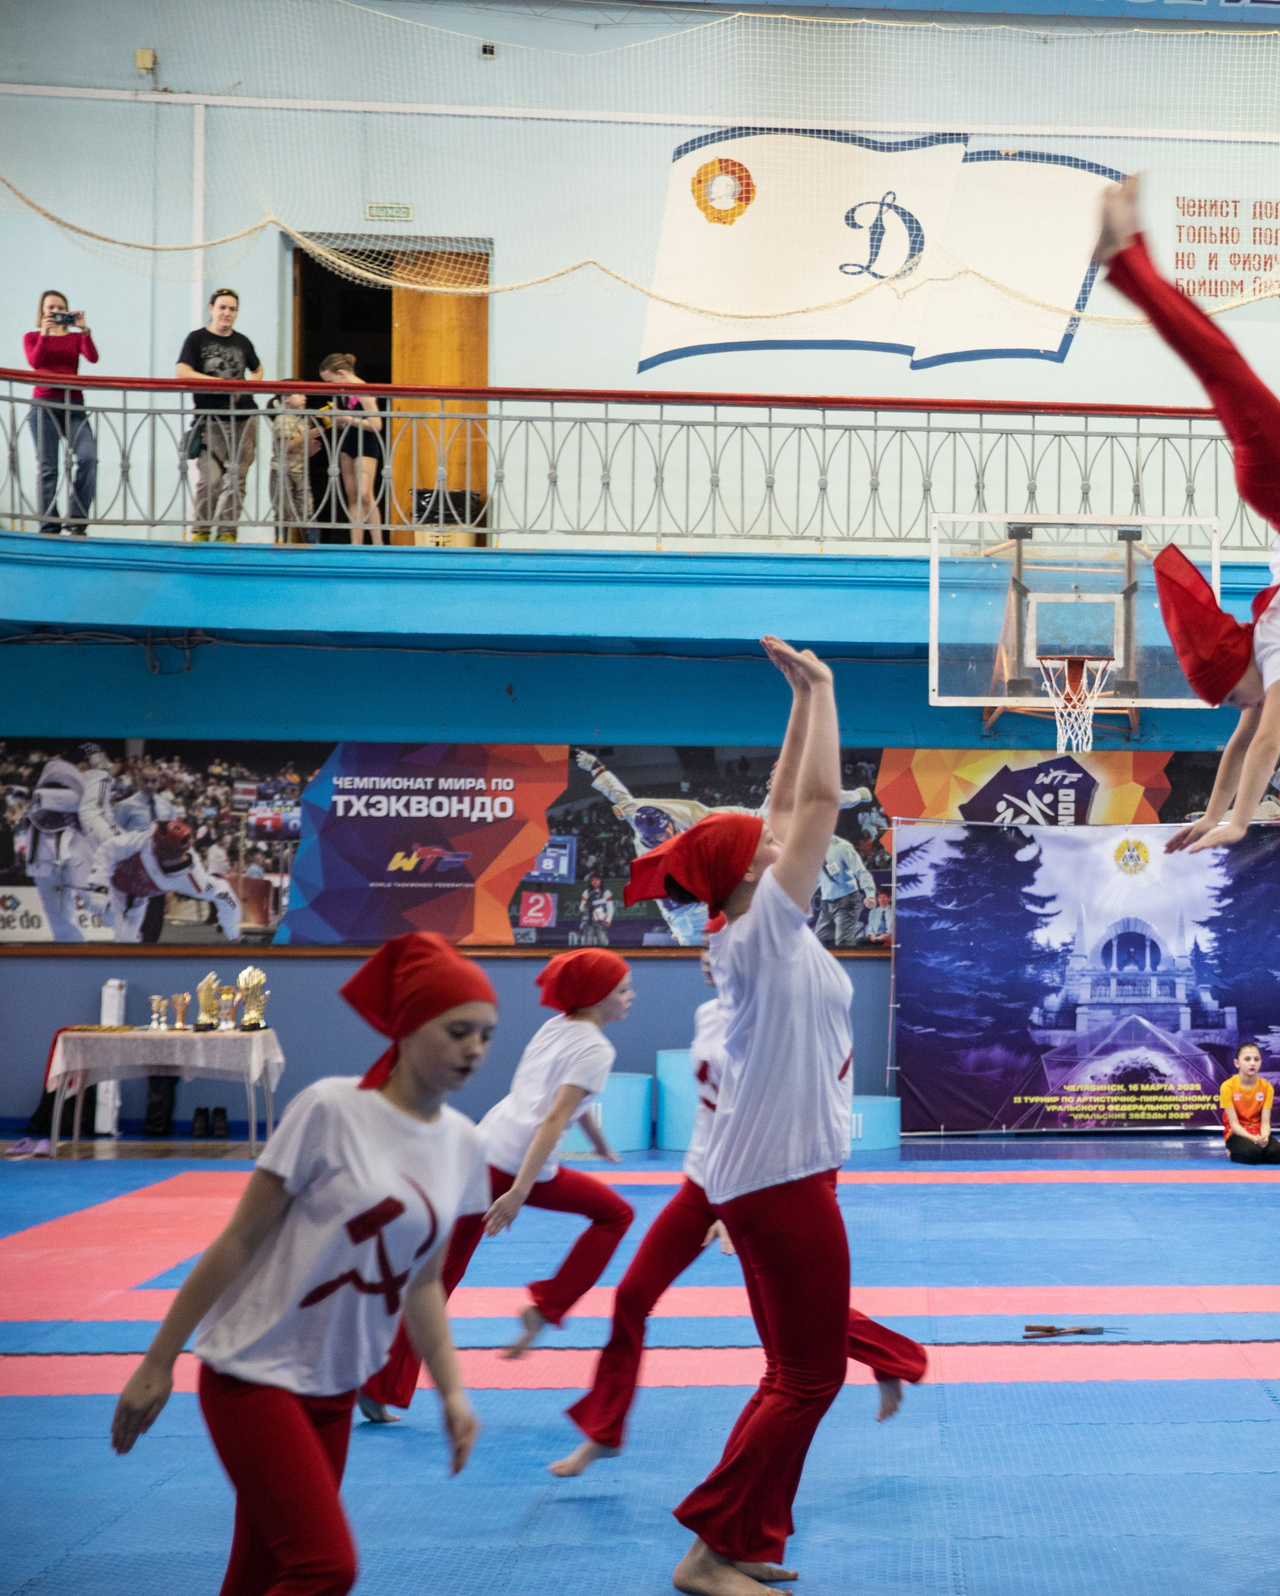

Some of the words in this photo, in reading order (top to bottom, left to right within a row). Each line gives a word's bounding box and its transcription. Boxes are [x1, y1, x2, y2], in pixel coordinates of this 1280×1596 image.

[332, 776, 434, 790] ЧЕМПИОНАТ
[438, 777, 487, 791] МИРА
[491, 778, 515, 791] ПО
[331, 795, 515, 822] ТХЭКВОНДО
[386, 843, 471, 873] WTF
[527, 894, 545, 917] 2
[1140, 1083, 1175, 1091] МАРТА
[1045, 1104, 1105, 1112] УРАЛЬСКОГО
[1107, 1104, 1180, 1112] ФЕДЕРАЛЬНОГО
[1182, 1103, 1217, 1111] ОКРУГА
